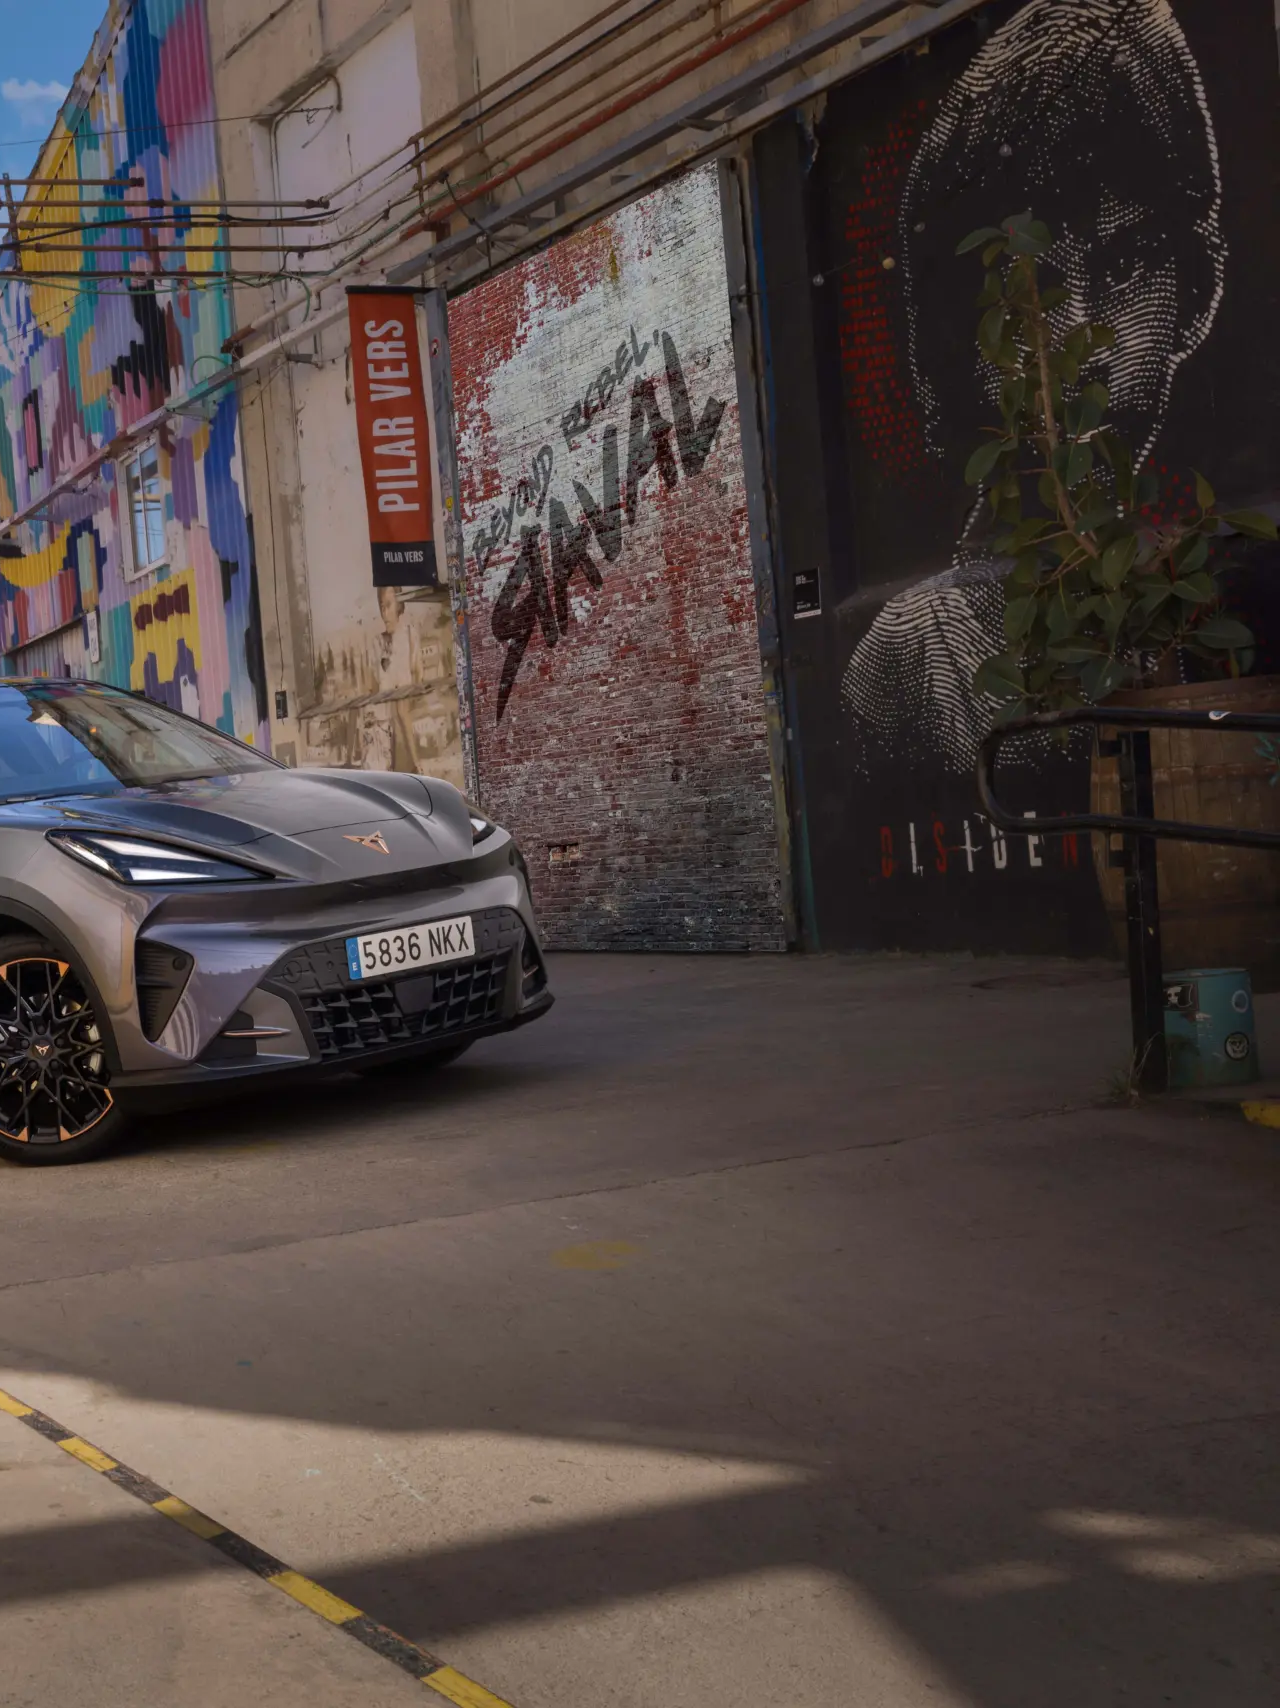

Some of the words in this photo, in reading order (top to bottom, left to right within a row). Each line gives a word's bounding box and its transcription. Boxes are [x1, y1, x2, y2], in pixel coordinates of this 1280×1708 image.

[364, 319, 412, 402] VERS
[372, 416, 420, 513] PILAR
[472, 445, 554, 576] BEYOND
[383, 551, 404, 563] PILAR
[404, 551, 424, 563] VERS
[351, 961, 359, 971] E
[362, 932, 422, 970] 5836
[427, 921, 470, 958] NKX
